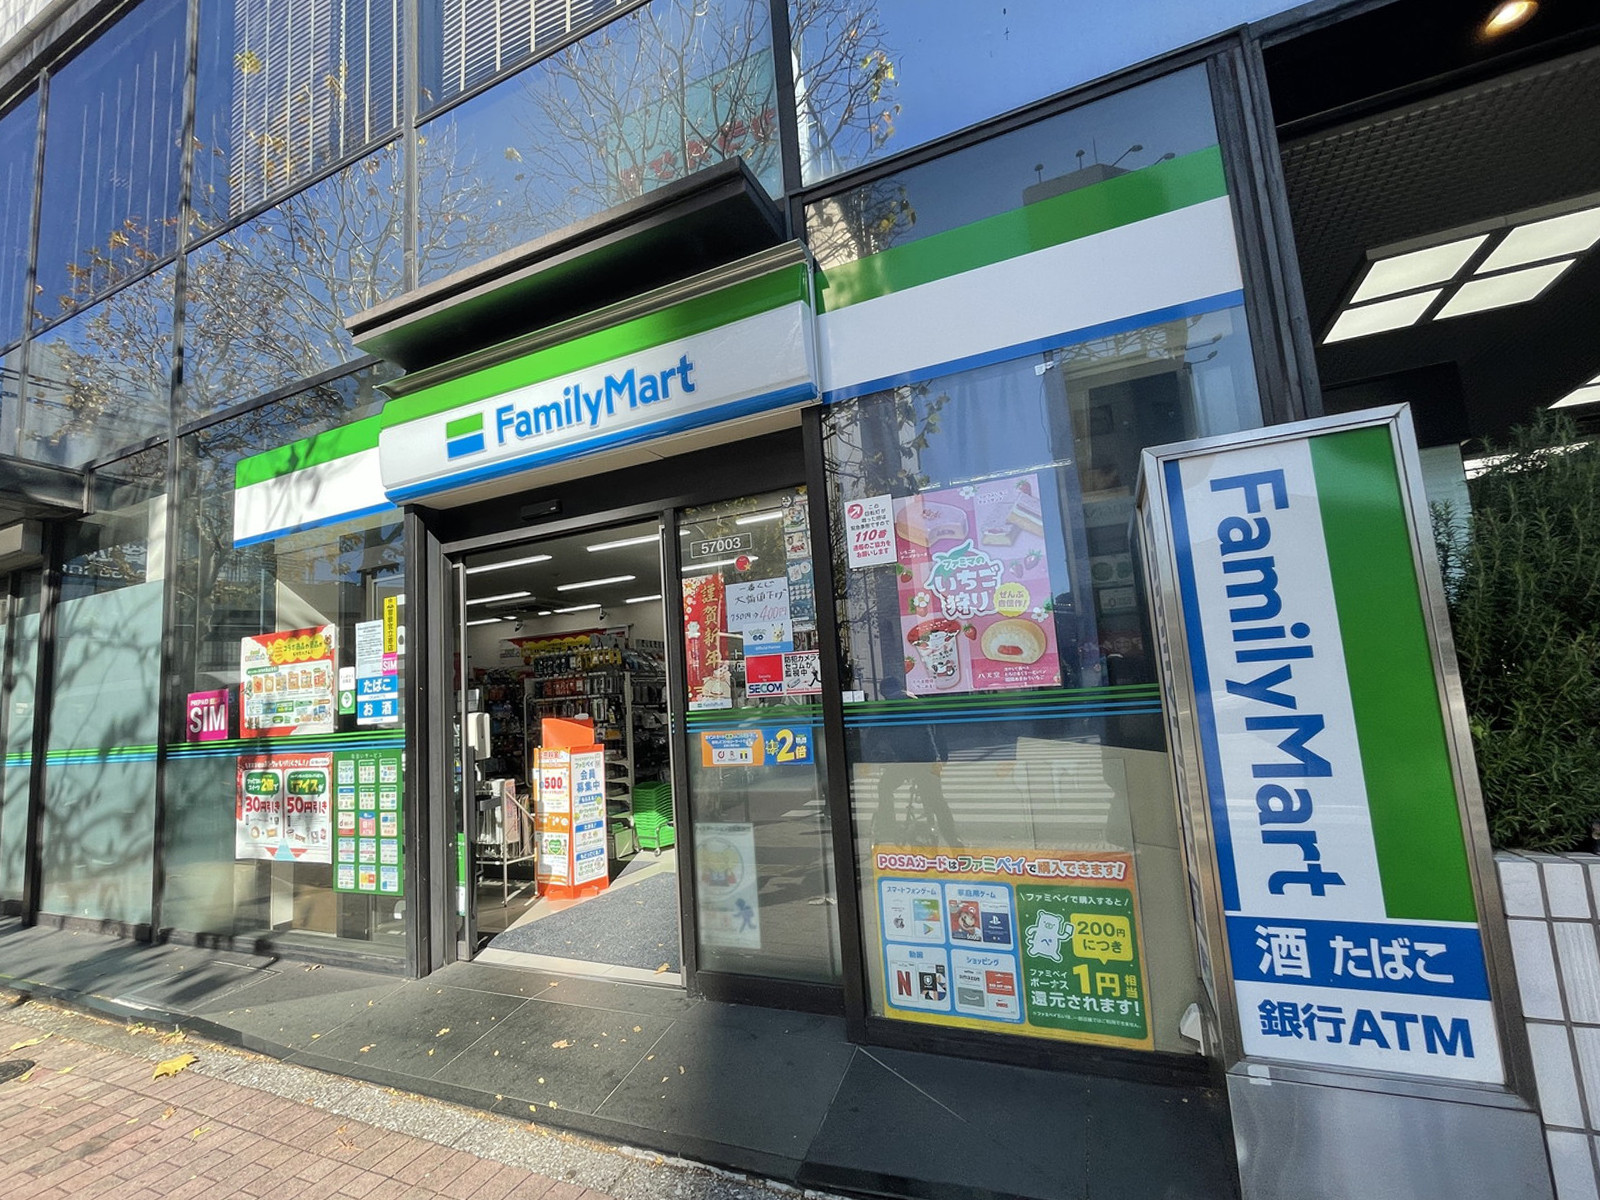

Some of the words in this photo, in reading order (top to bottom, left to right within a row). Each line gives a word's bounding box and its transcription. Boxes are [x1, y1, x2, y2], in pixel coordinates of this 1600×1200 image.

[496, 354, 695, 444] FamilyMart
[856, 529, 887, 542] 110番
[701, 537, 741, 554] 57003
[944, 557, 984, 570] ファミマの
[935, 564, 999, 592] いちご
[946, 591, 988, 614] 狩り
[1000, 590, 1024, 599] ぜんぶ
[701, 583, 722, 669] 謹賀新年
[383, 660, 397, 671] SIM
[363, 678, 392, 694] たばこ
[748, 683, 783, 695] SECOM
[1210, 468, 1346, 897] FamilyMart
[363, 702, 373, 717] お
[382, 701, 393, 716] 酒
[190, 704, 225, 733] SIM
[545, 777, 562, 789] 500
[245, 796, 280, 814] 30円引き
[287, 796, 327, 814] 50円引き
[879, 855, 1125, 880] POSAカードはファミペイで購入できます!
[887, 886, 937, 896] スマートフォンゲーム
[1026, 893, 1122, 907] ファミペイで購入すると
[1077, 921, 1126, 938] 200円
[1083, 939, 1122, 954] につき
[1255, 924, 1311, 978] 酒
[1329, 935, 1454, 984] たばこ
[966, 957, 999, 967] ショッピング
[1030, 968, 1068, 979] ファミペイ
[1072, 964, 1121, 997] 1円
[1030, 979, 1069, 991] ボーナス
[1124, 974, 1138, 999] 相当
[1031, 990, 1140, 1017] 還元されます!
[1258, 999, 1475, 1058] 銀行ATM
